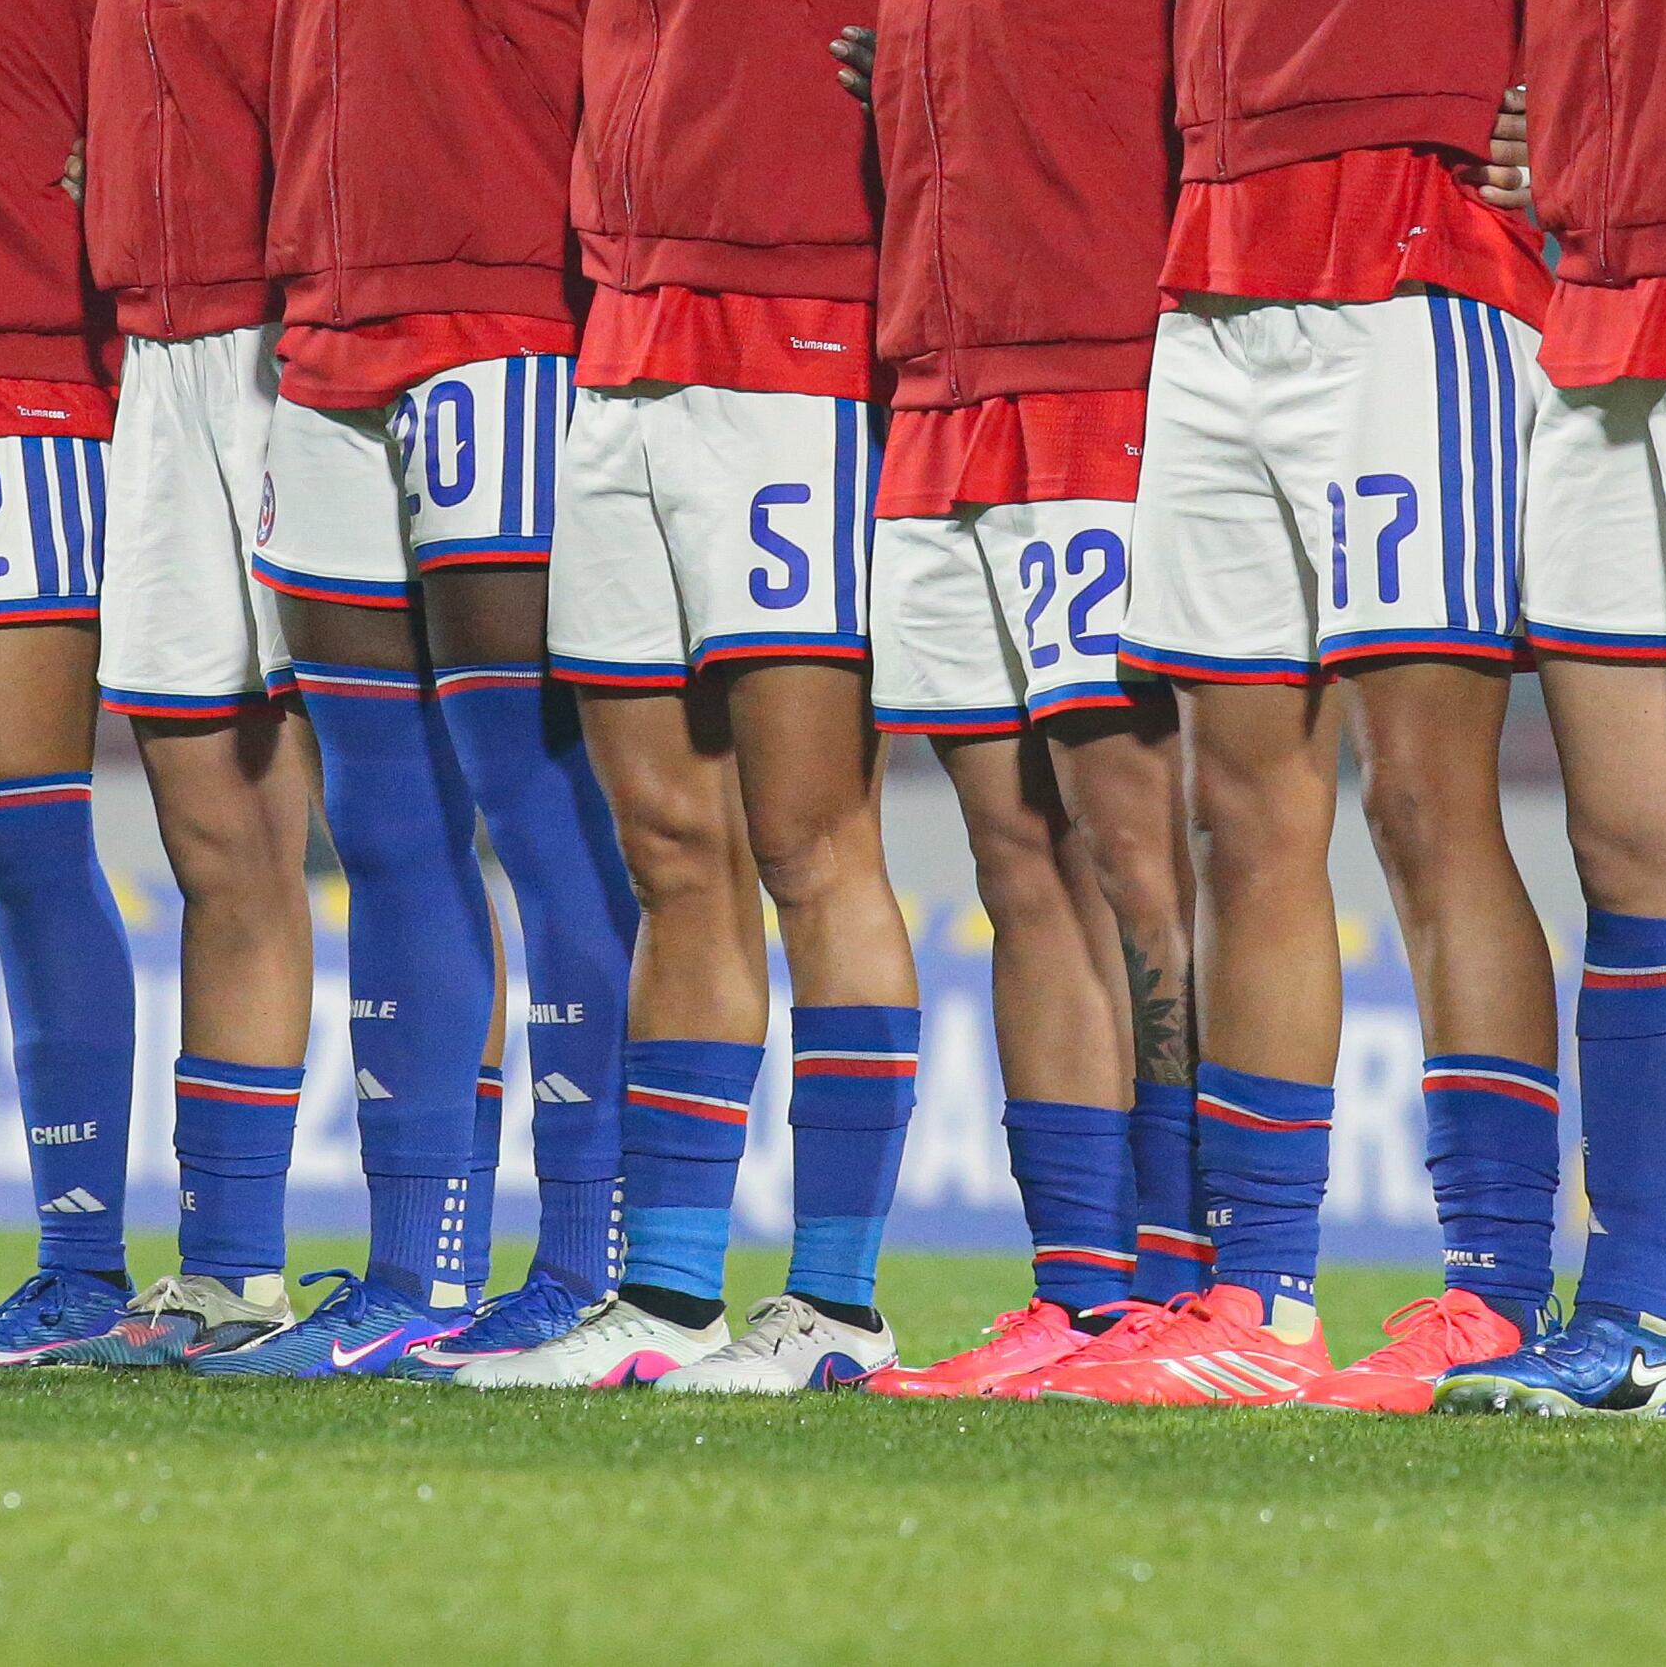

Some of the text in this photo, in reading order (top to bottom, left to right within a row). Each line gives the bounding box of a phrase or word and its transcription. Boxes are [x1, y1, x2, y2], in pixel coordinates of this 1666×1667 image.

[748, 483, 811, 610] 5
[1020, 529, 1127, 669] 22
[1327, 474, 1418, 609] 17
[31, 1120, 97, 1145] CHILE
